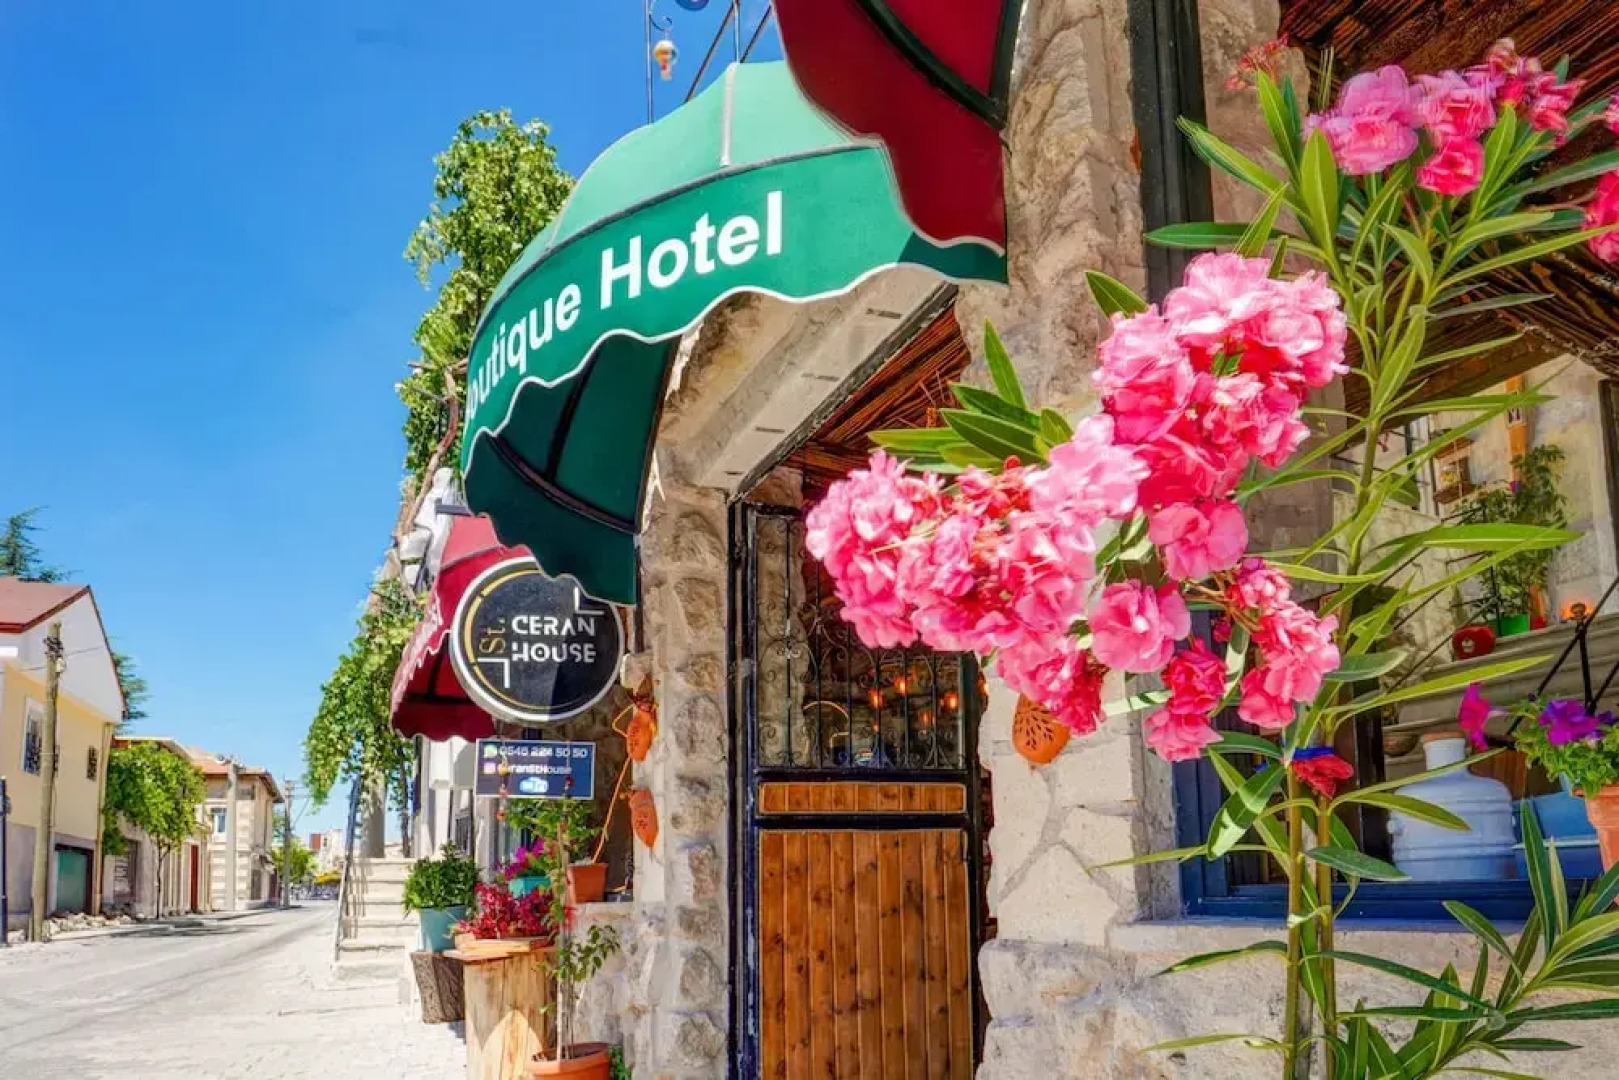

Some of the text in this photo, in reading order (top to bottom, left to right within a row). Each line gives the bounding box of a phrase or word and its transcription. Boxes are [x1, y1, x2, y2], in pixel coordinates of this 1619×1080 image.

[599, 190, 783, 310] Hotel
[511, 614, 596, 637] CERAN
[511, 640, 597, 664] HOUSE
